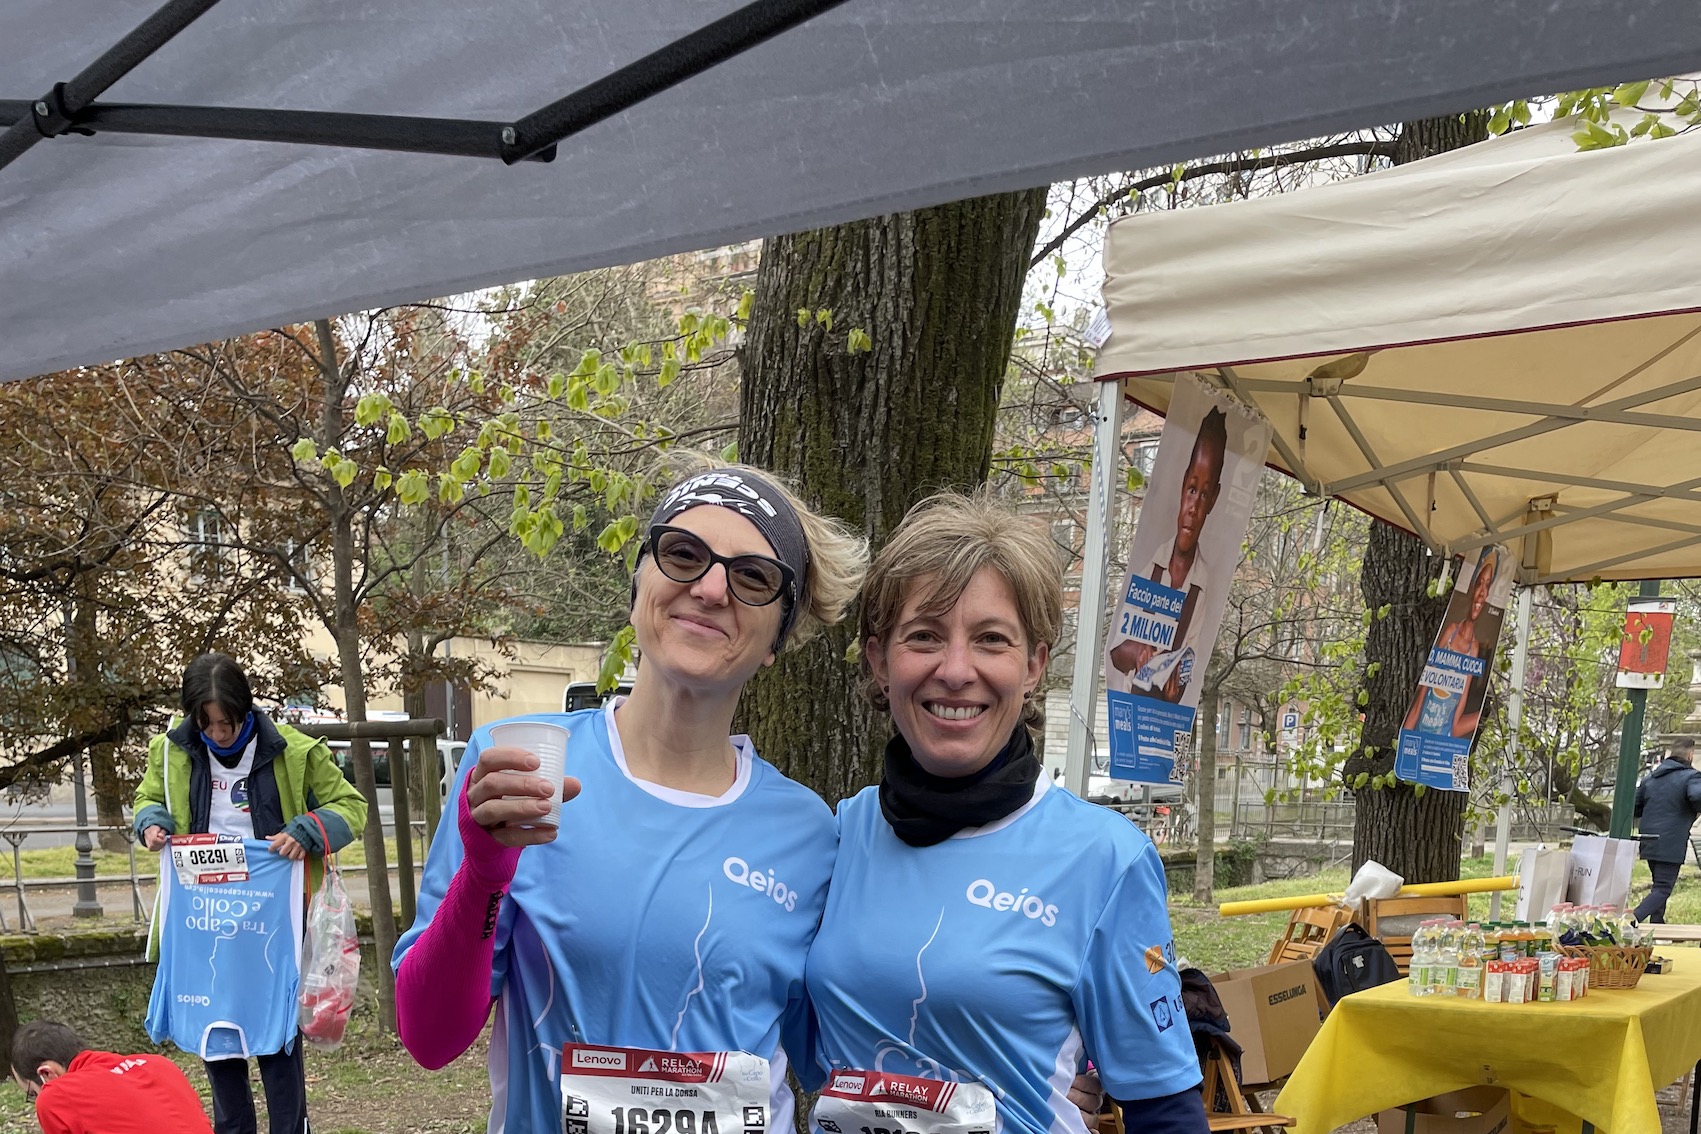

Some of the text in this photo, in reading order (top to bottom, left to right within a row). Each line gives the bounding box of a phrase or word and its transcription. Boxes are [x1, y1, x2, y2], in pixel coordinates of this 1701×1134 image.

[1128, 583, 1183, 613] Faccio parte dei
[1121, 612, 1174, 646] 2 MILIONI
[1424, 671, 1465, 690] VOLONTARIA
[1286, 716, 1295, 726] P
[190, 849, 229, 865] 1623C
[723, 856, 798, 913] Qeios
[192, 896, 261, 917] e Collo
[966, 878, 1060, 928] Qeios
[186, 915, 268, 936] Tra Capo
[177, 994, 211, 1007] Qeios
[1268, 984, 1307, 1006] ESSELUNGA
[577, 1053, 621, 1066] Lenovo
[661, 1058, 702, 1068] RELAY
[631, 1085, 650, 1096] UNITI
[651, 1087, 664, 1096] PER
[665, 1088, 674, 1097] LA
[835, 1077, 862, 1090] Lenovo
[890, 1082, 929, 1095] RELAY
[890, 1091, 928, 1102] MARATHON
